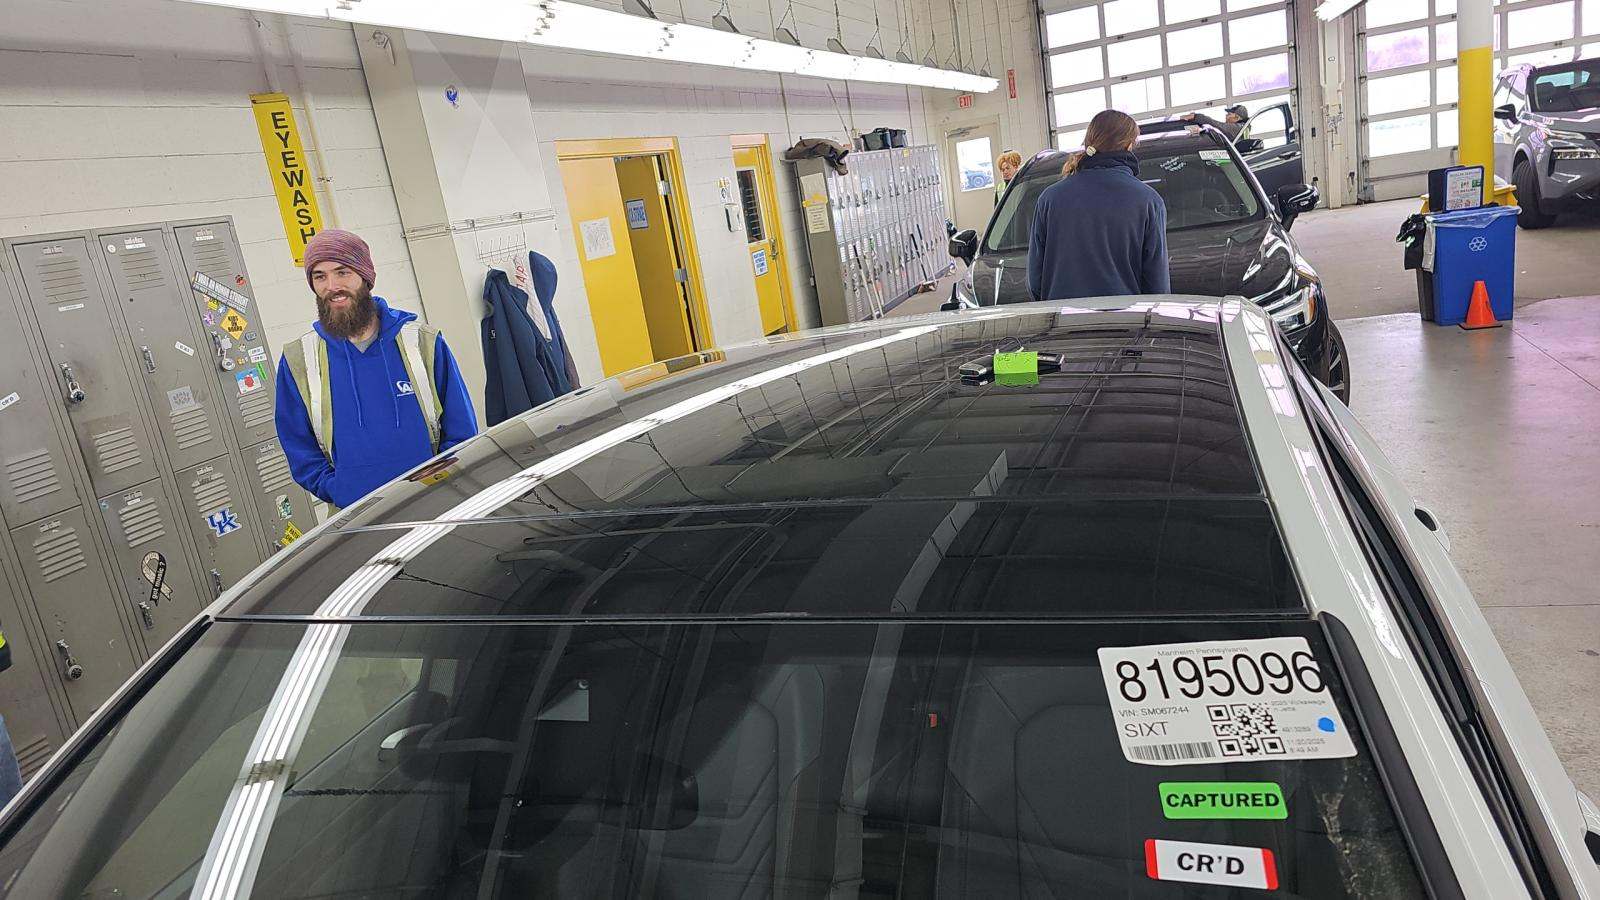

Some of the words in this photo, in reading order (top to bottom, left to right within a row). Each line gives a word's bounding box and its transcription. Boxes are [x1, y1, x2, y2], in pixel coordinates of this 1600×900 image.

[271, 111, 316, 244] EYEWASH
[151, 588, 160, 600] got
[1195, 646, 1249, 654] Pennsylvania
[1115, 651, 1326, 703] 8195096
[1118, 708, 1138, 718] VIN:
[1124, 721, 1169, 738] SIXT
[1165, 793, 1280, 808] CAPTURED
[1176, 852, 1245, 875] CR'D
